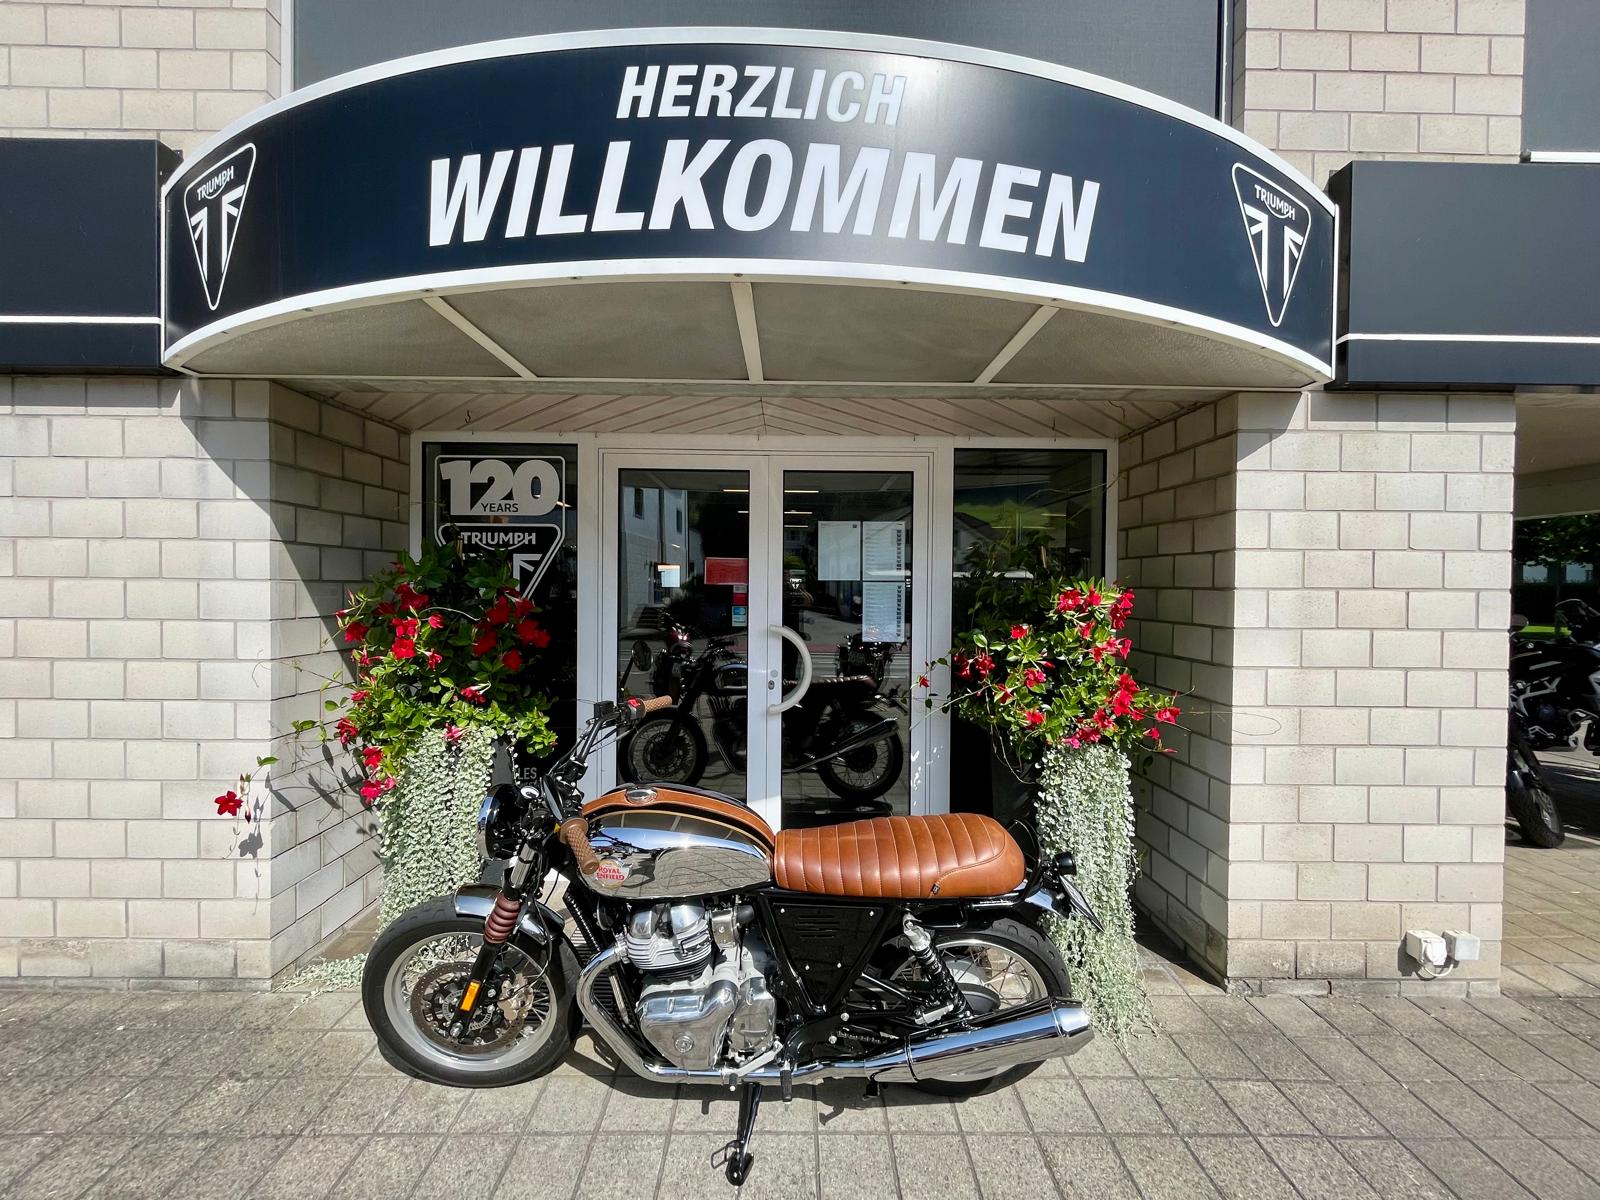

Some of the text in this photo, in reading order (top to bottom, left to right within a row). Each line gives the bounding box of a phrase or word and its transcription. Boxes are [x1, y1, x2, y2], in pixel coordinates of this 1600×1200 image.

[616, 65, 907, 126] HERZLICH
[197, 166, 234, 200] TRIUMPH
[429, 139, 1100, 263] WILLKOMMEN
[1254, 184, 1295, 221] TRIUMPH
[440, 459, 561, 516] 120
[481, 503, 519, 513] YEARS
[461, 532, 536, 549] TRIUMPH
